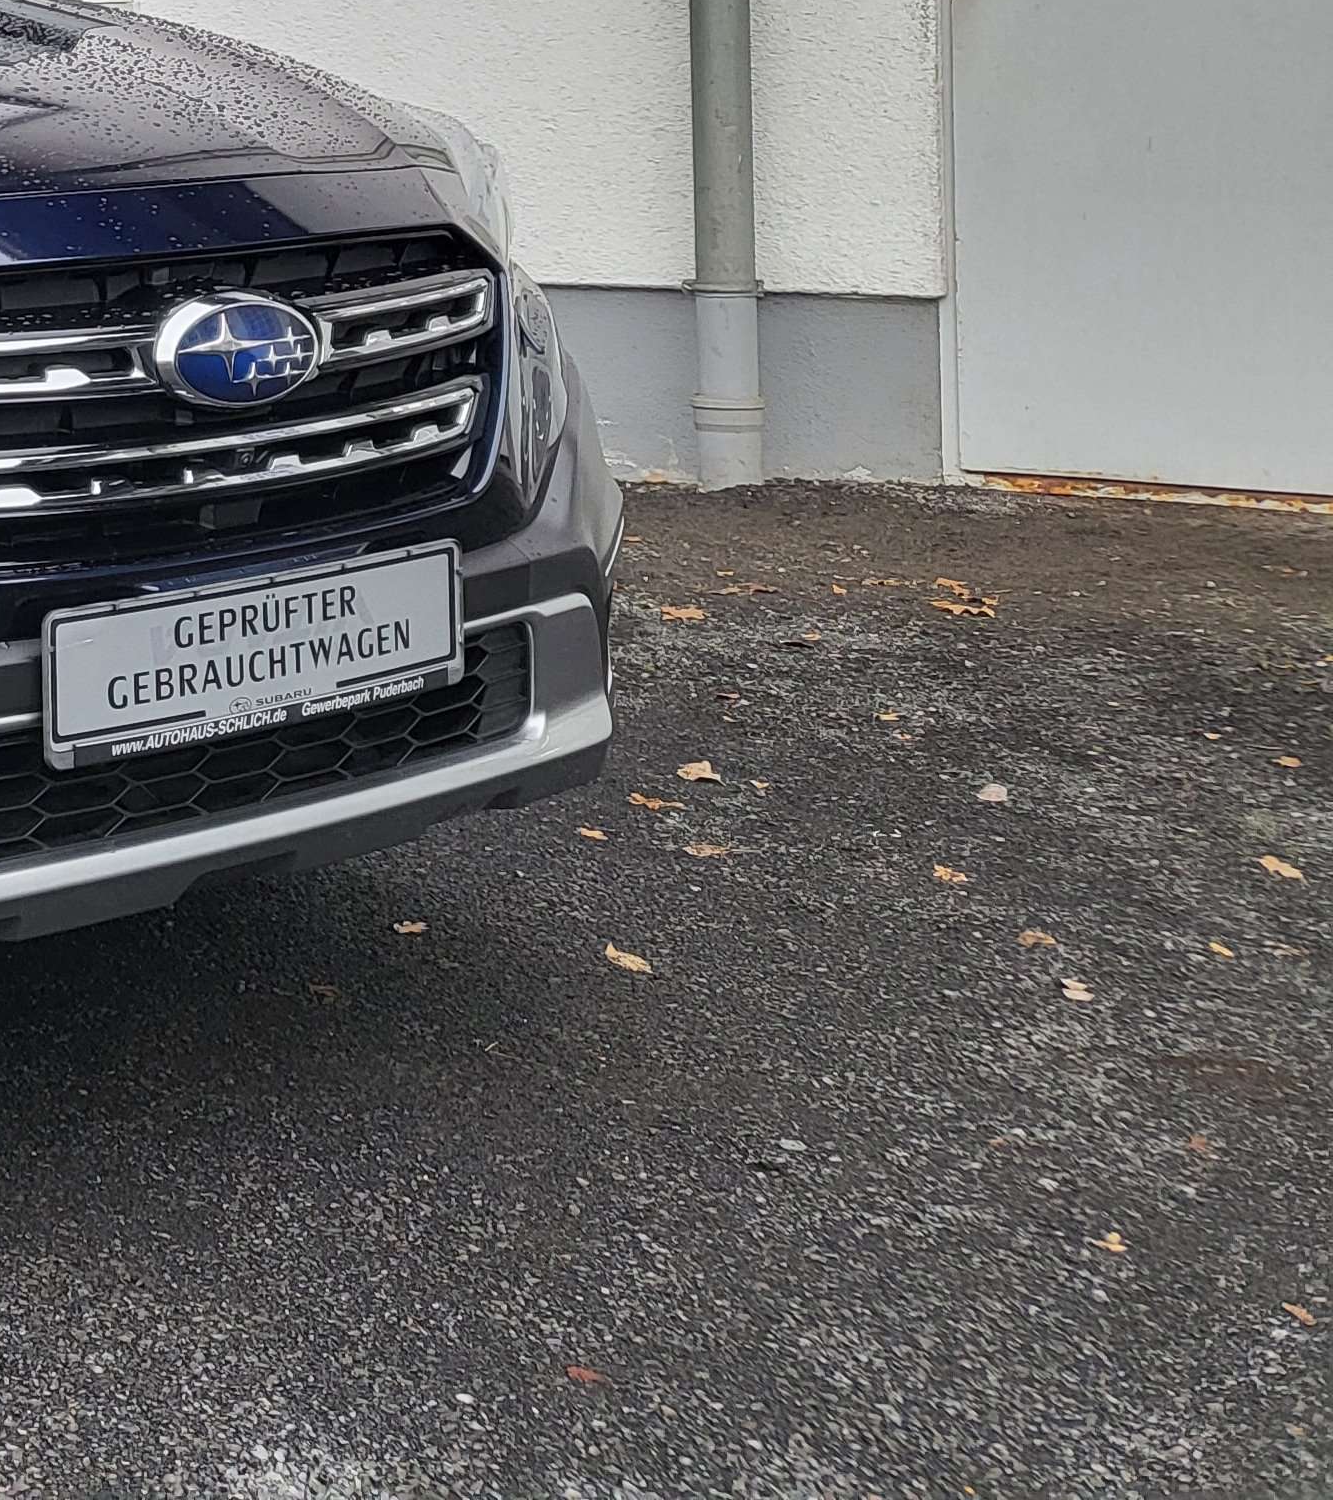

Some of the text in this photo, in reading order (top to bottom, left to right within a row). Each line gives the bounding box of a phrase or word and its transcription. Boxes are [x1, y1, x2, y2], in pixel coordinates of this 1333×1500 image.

[174, 585, 357, 649] GEPRÜFTER
[107, 618, 411, 709] GEBRAUCHTWAGEN
[255, 687, 313, 707] SUBARU
[111, 676, 424, 757] www.AUTOHAUS-SCHLICH.de Gewerbepark Puderbach
